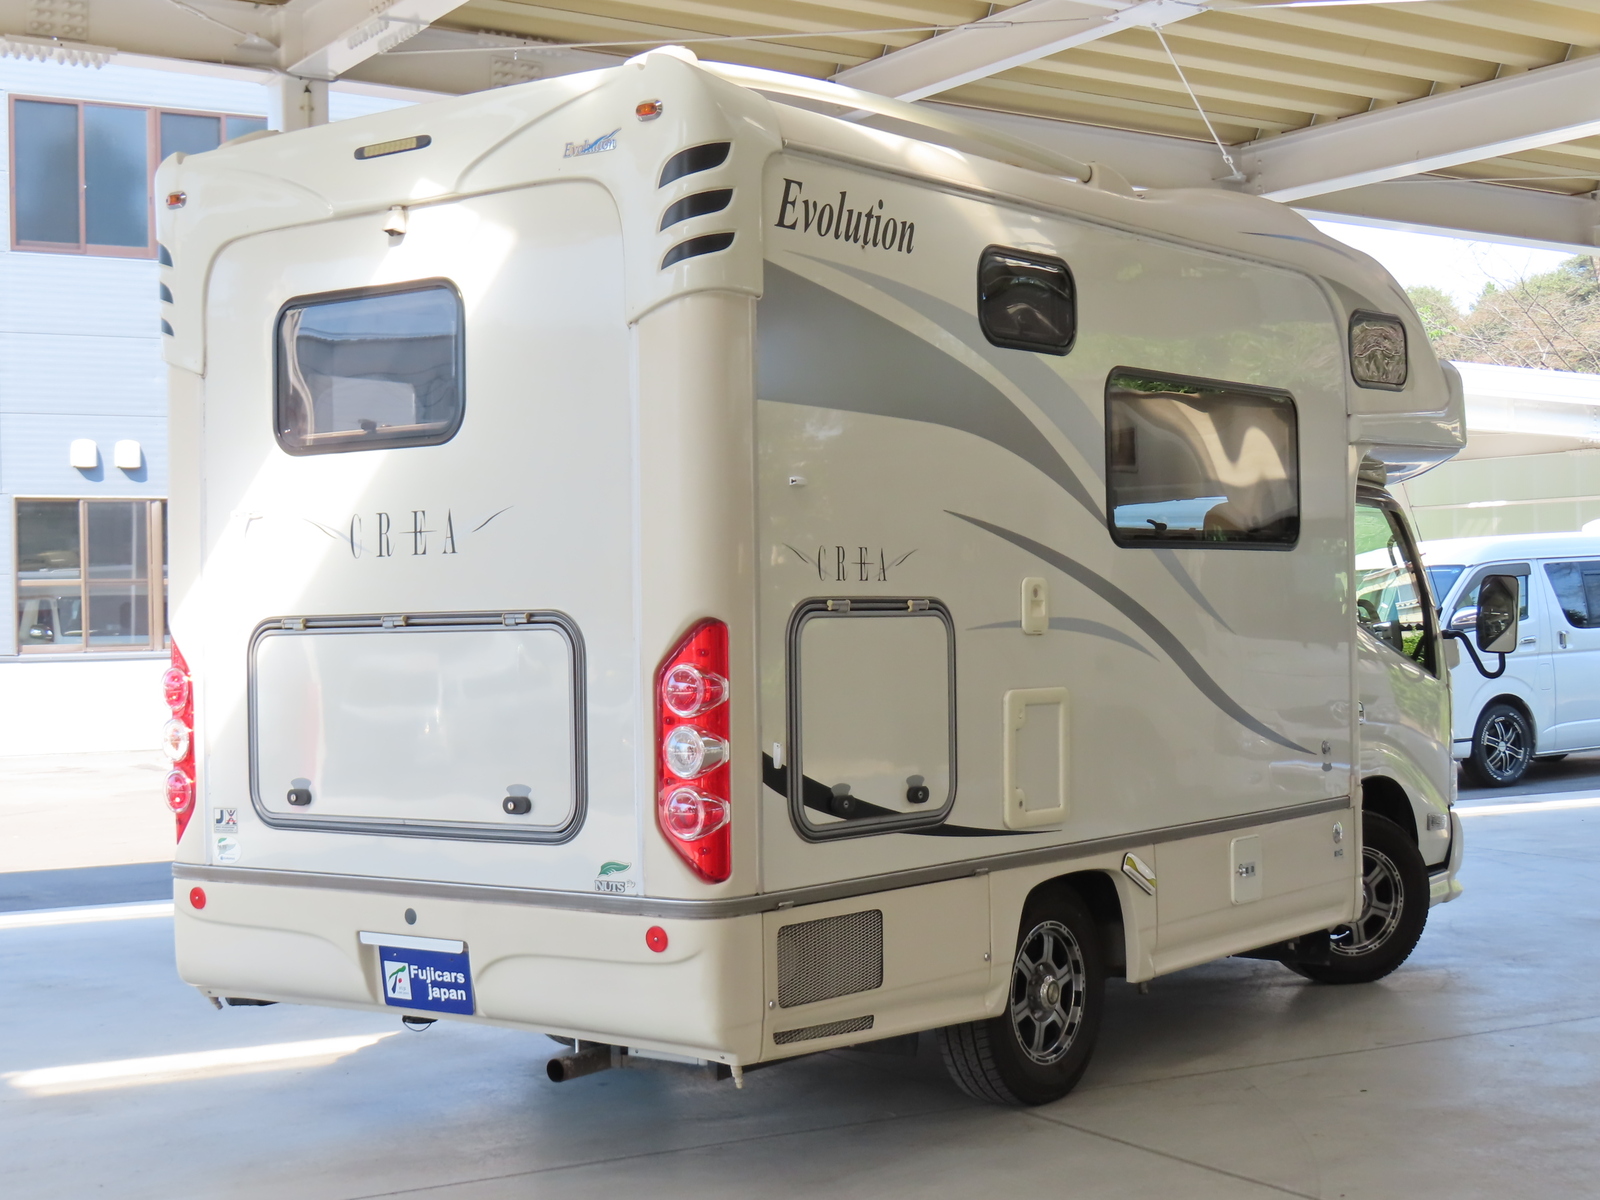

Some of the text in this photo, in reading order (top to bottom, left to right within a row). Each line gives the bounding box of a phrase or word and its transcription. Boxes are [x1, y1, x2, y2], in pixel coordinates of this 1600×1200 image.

[774, 177, 915, 254] Evolution
[350, 508, 458, 559] CREA
[817, 545, 888, 581] CREA
[594, 880, 626, 893] NUTS
[410, 965, 465, 983] Fujicars
[428, 984, 467, 1001] japan
